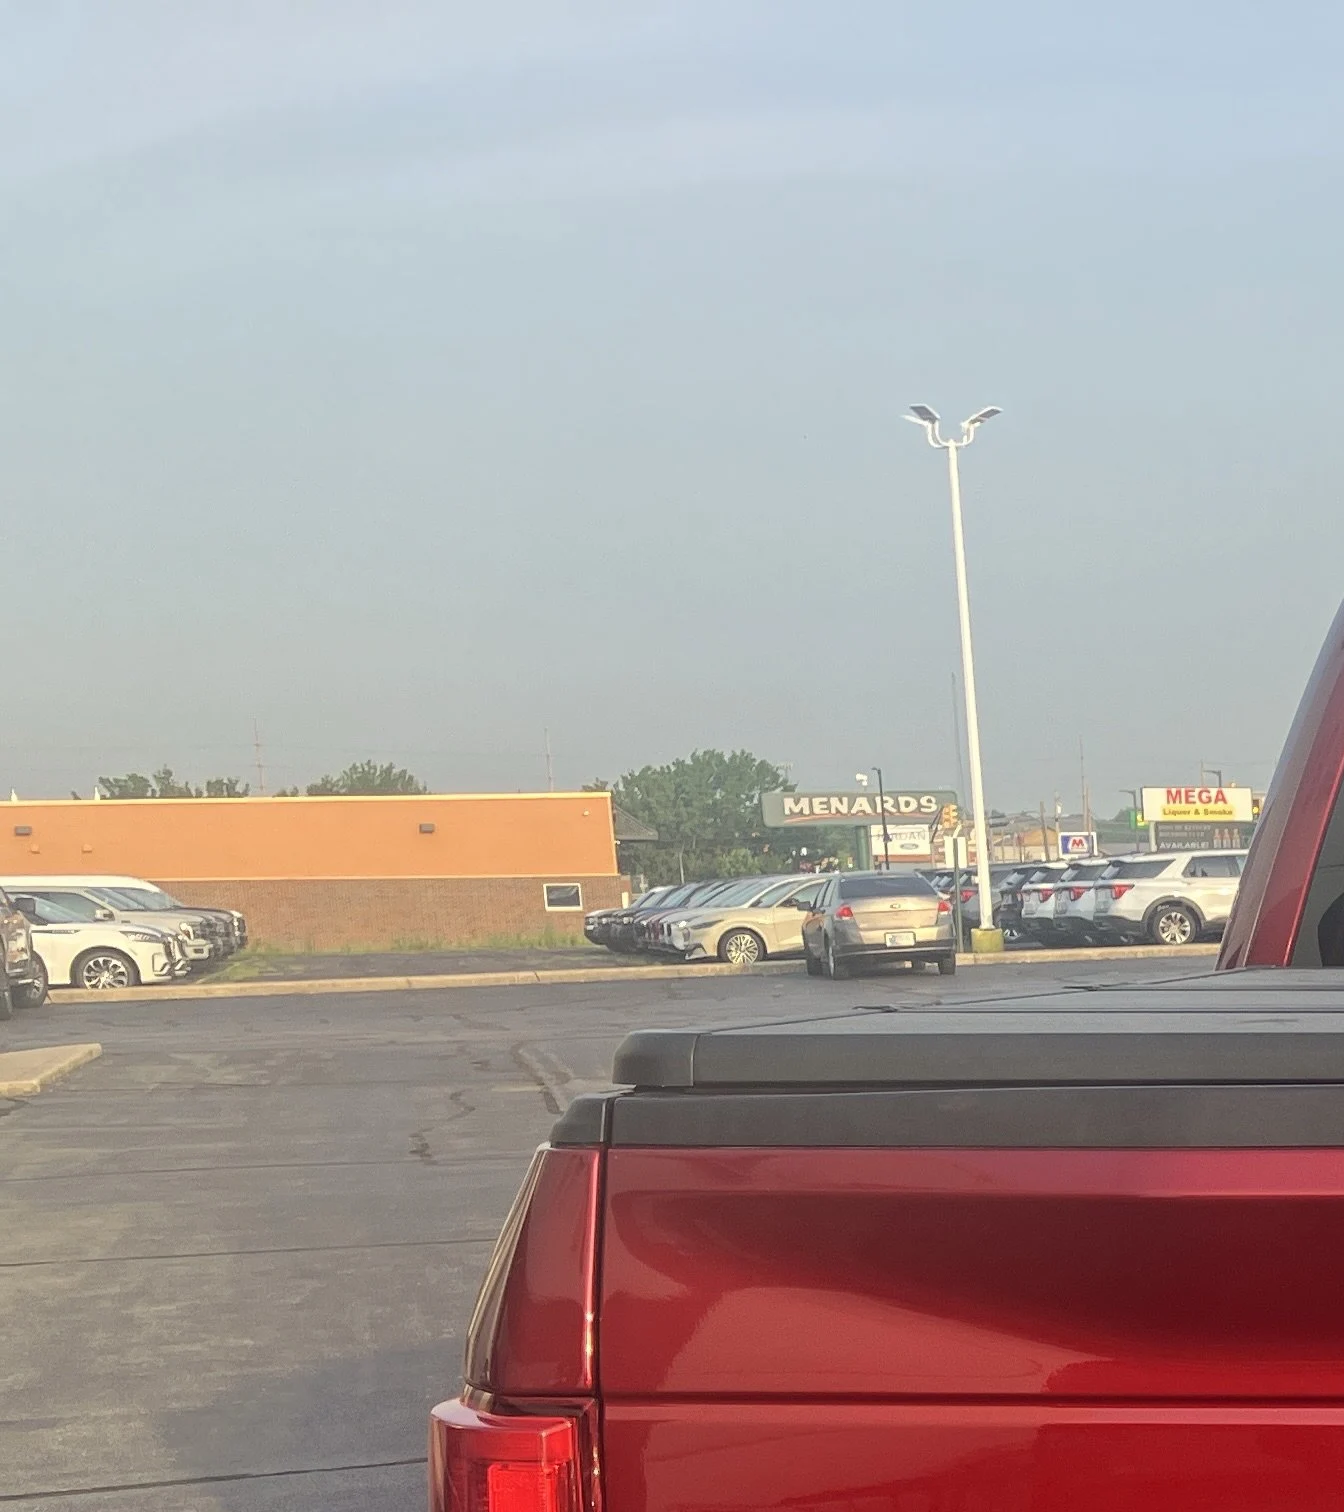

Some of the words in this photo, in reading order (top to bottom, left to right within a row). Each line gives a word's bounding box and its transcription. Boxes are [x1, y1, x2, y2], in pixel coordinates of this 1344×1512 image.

[783, 795, 938, 815] MENARDS
[1166, 787, 1228, 805] MEGA
[1194, 808, 1201, 816] &
